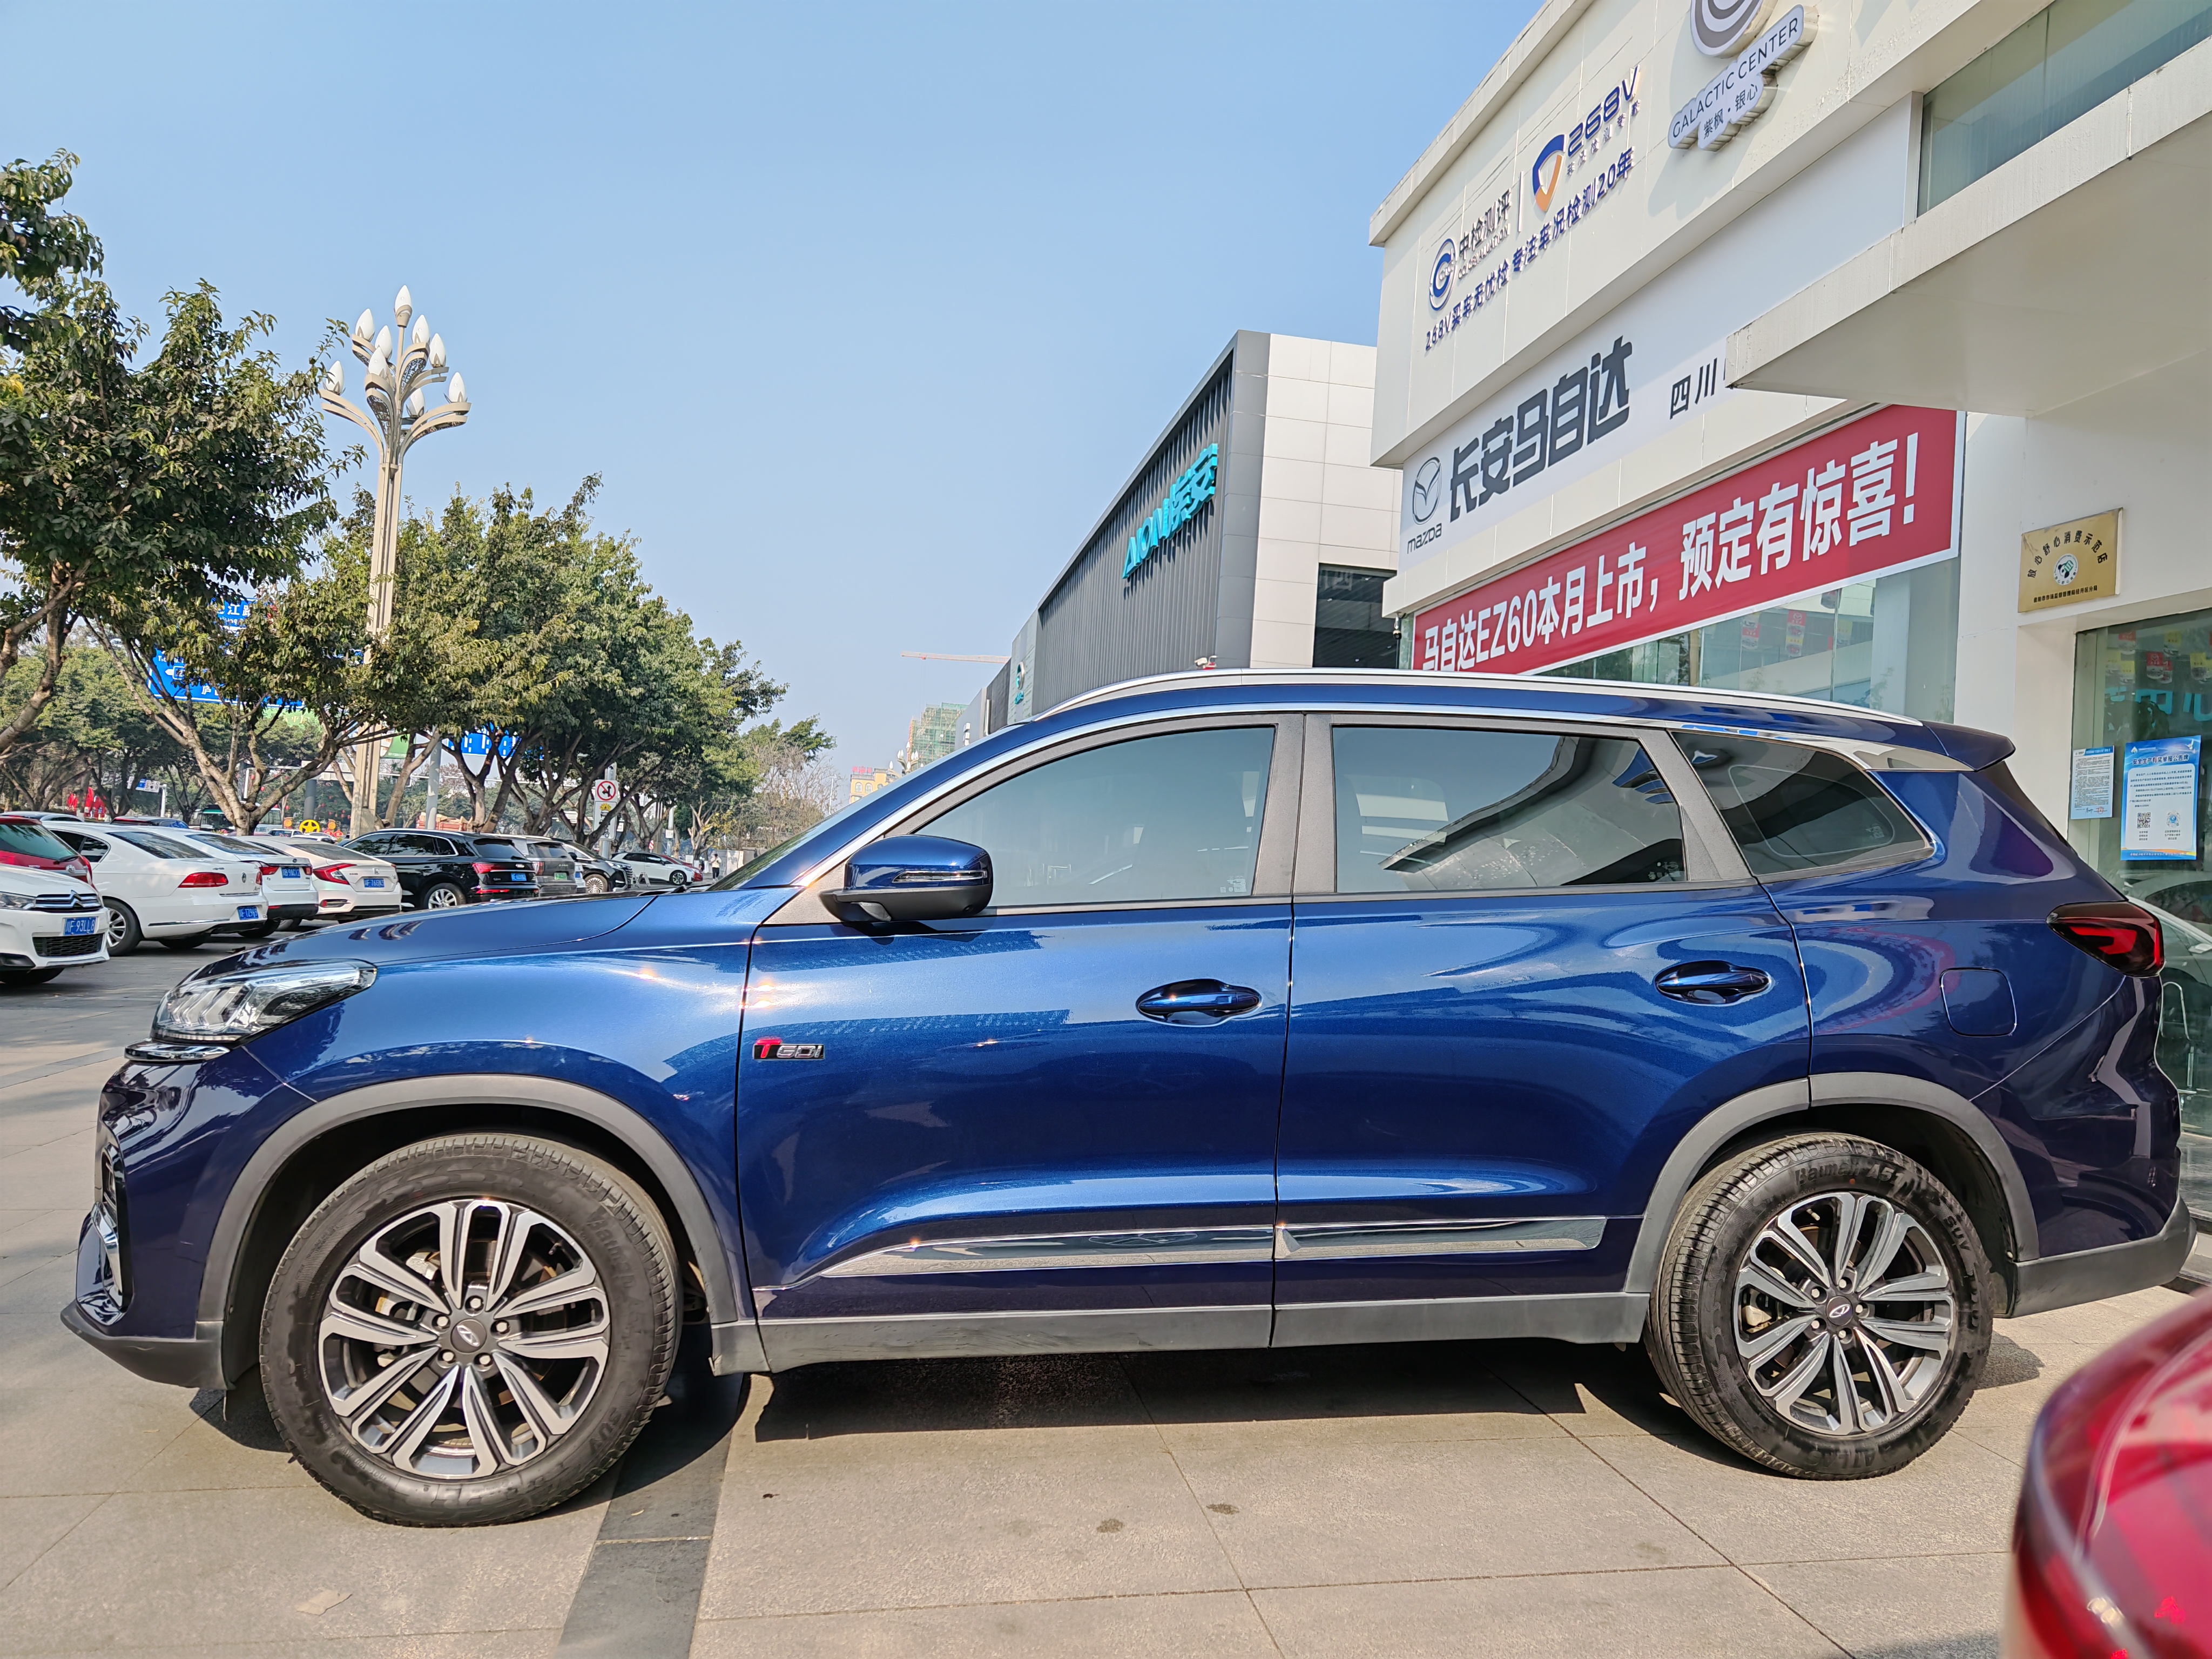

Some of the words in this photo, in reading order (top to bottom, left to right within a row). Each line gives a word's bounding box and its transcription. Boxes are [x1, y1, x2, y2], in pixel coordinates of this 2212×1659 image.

[1568, 65, 1640, 157] 268V
[1673, 71, 1734, 138] GALACTIC
[1738, 18, 1797, 79] CENTER
[1459, 188, 1512, 260] 中检测评
[1669, 357, 1726, 420] 四川
[1450, 335, 1632, 523] 长安马自达
[2027, 530, 2108, 578] 放心舒心消费示范店
[2132, 754, 2190, 765] 安全生产有奖举报公告牌
